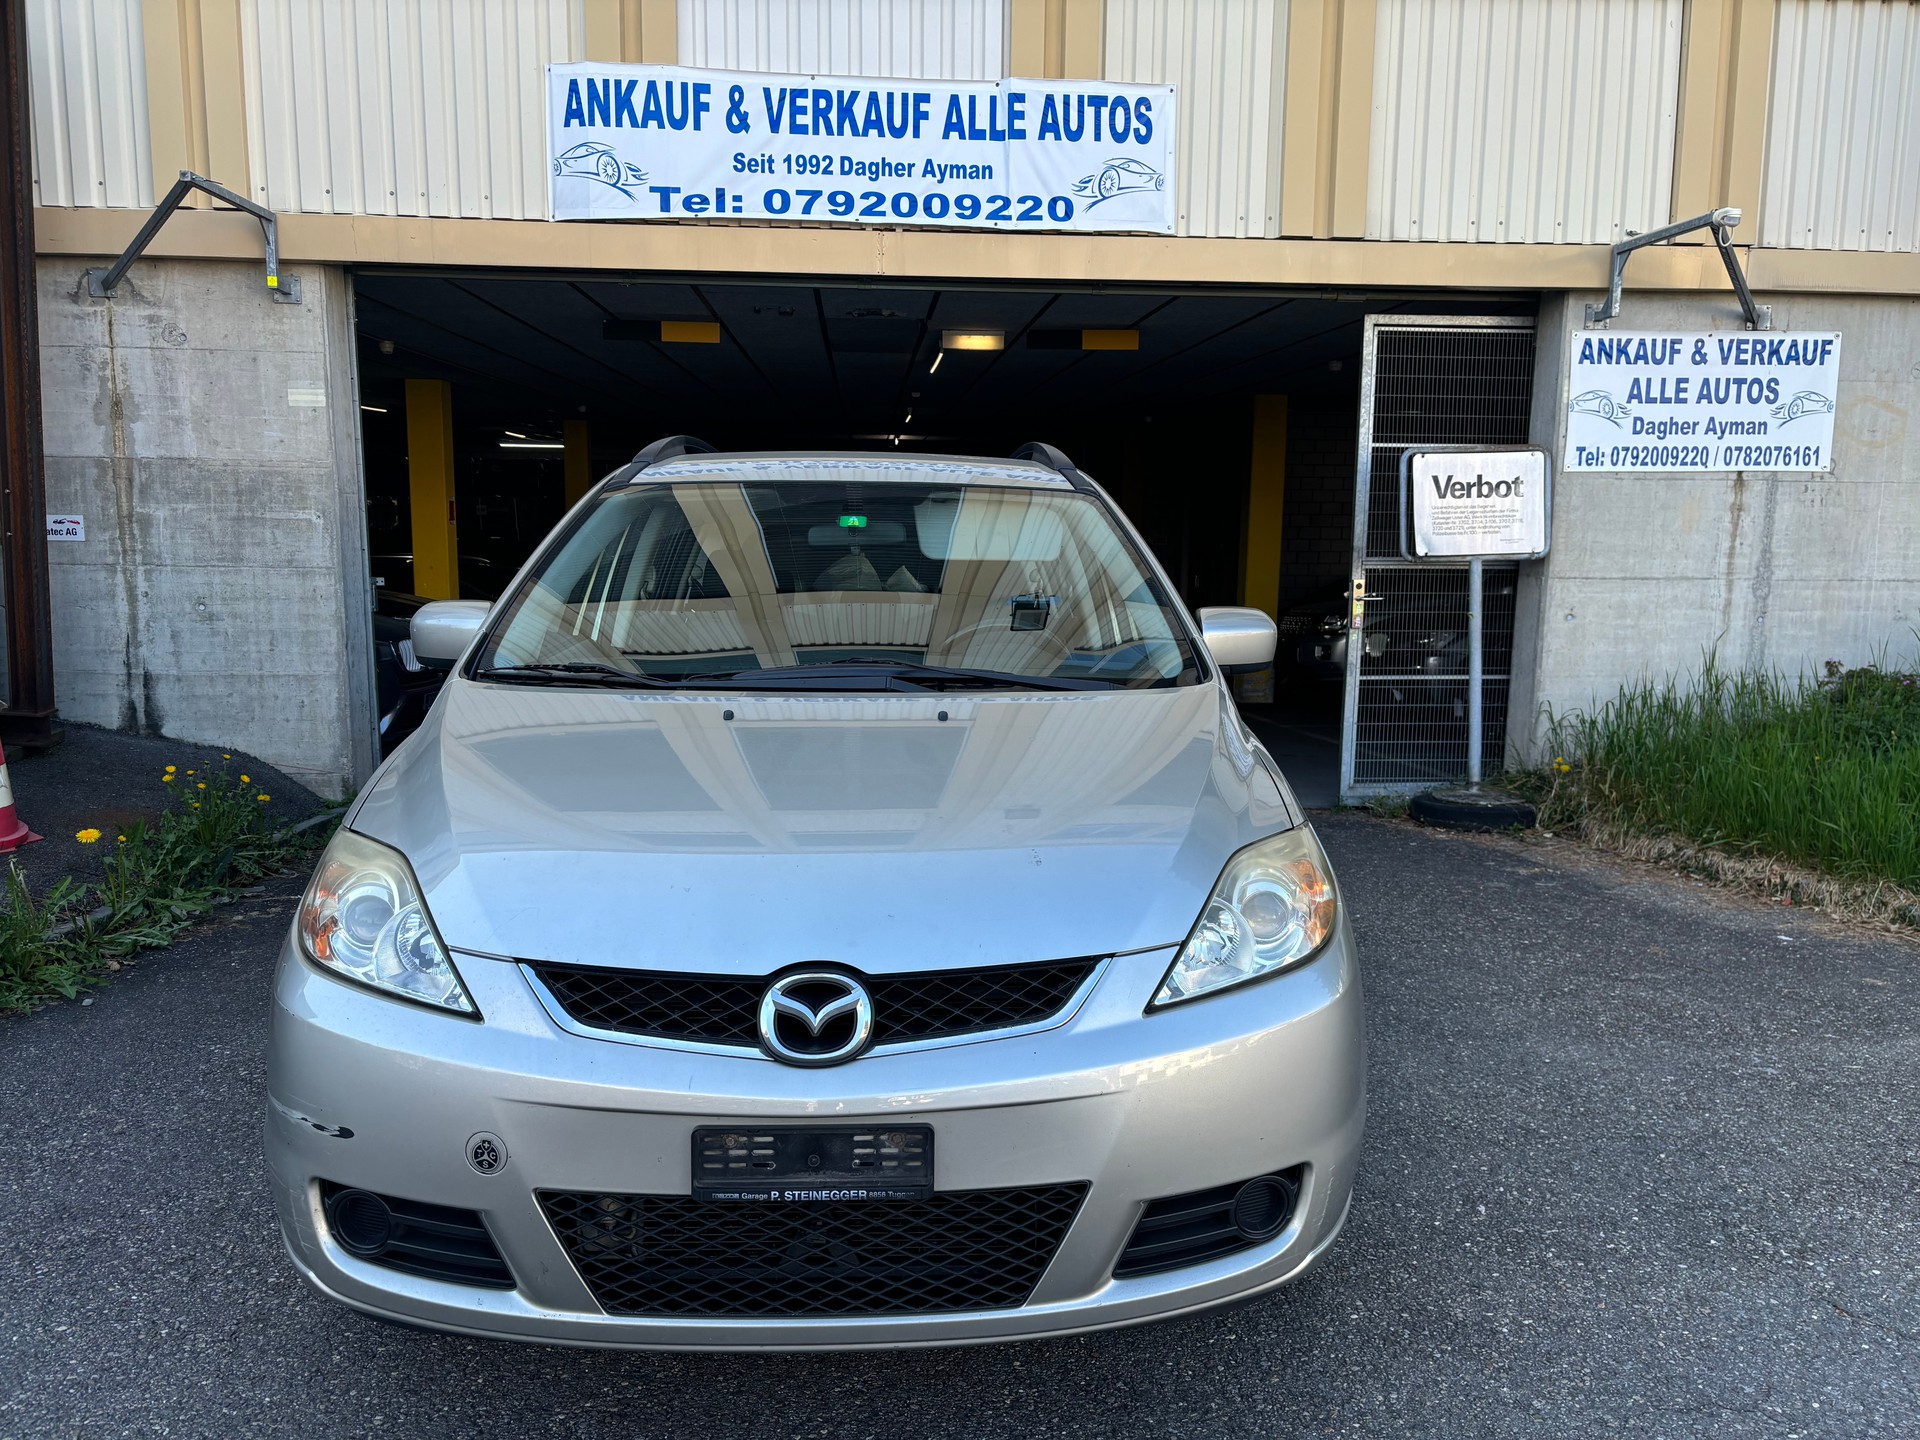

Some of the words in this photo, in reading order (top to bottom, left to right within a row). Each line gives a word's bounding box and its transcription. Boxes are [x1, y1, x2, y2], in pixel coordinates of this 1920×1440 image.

[563, 78, 711, 131] ANKAUF
[725, 84, 751, 134] &
[763, 87, 931, 139] VERKAUF
[942, 92, 1027, 141] ALLE
[1038, 93, 1153, 145] AUTOS
[733, 152, 775, 174] Seit
[782, 154, 834, 175] 1992
[840, 155, 915, 182] Dagher
[922, 158, 993, 183] Ayman
[649, 186, 743, 213] Tel:
[763, 189, 1074, 222] 0792009220
[1578, 338, 1683, 365] ANKAUF
[1691, 338, 1709, 366] &
[1717, 339, 1834, 366] VERKAUF
[1626, 377, 1690, 404] ALLE
[1695, 377, 1780, 405] AUTOS
[1632, 416, 1699, 440] Dagher
[1704, 417, 1768, 439] Ayman
[1576, 446, 1605, 466] Tel:
[1610, 446, 1709, 466] 0792009220
[1713, 445, 1720, 466] /
[1723, 446, 1820, 466] 0782076161
[1431, 474, 1524, 499] Verbot
[66, 528, 77, 536] AG
[741, 1192, 768, 1200] Garage
[770, 1190, 781, 1201] P.
[784, 1190, 867, 1201] STEINEGGER
